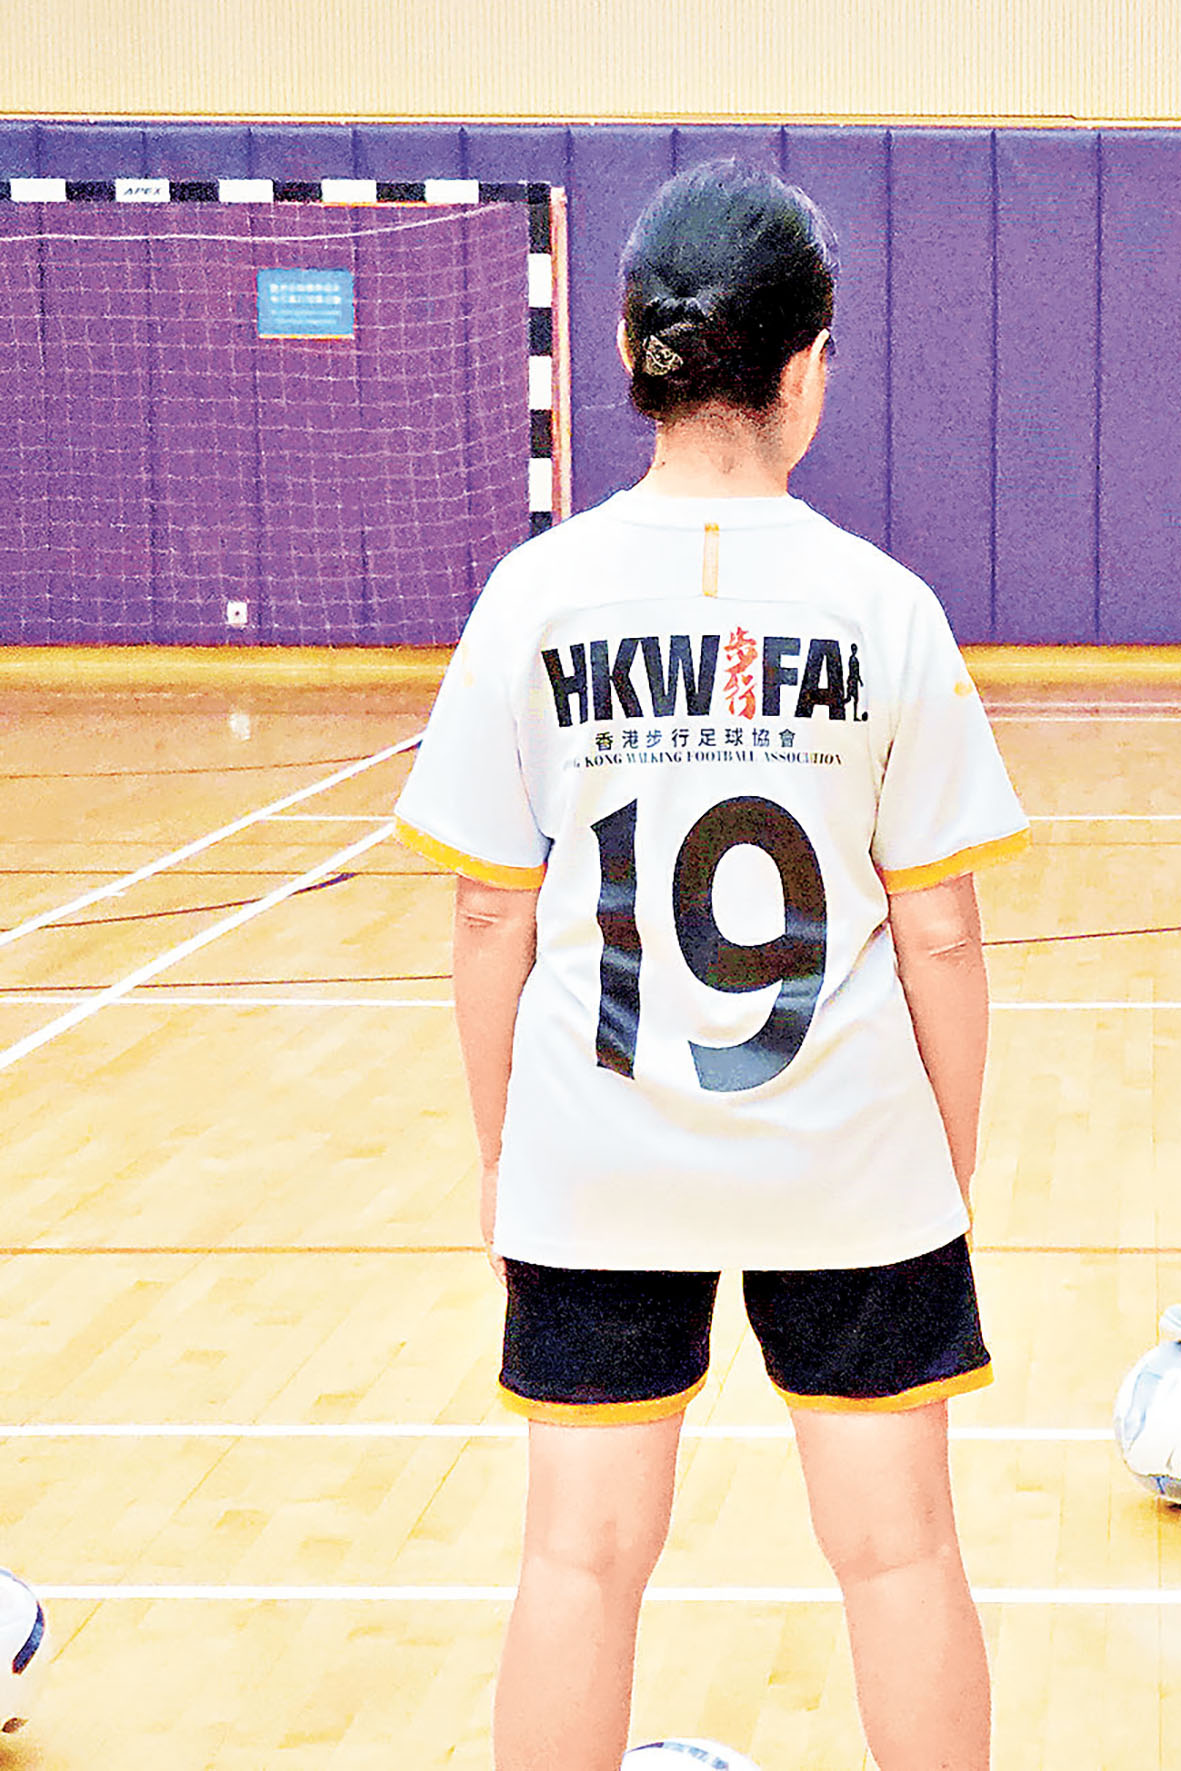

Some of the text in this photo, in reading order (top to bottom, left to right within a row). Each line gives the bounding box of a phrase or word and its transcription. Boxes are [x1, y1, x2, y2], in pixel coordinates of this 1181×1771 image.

[595, 728, 797, 751] 香港步行足球協會
[585, 753, 623, 767] KONG
[590, 796, 827, 1092] 19
